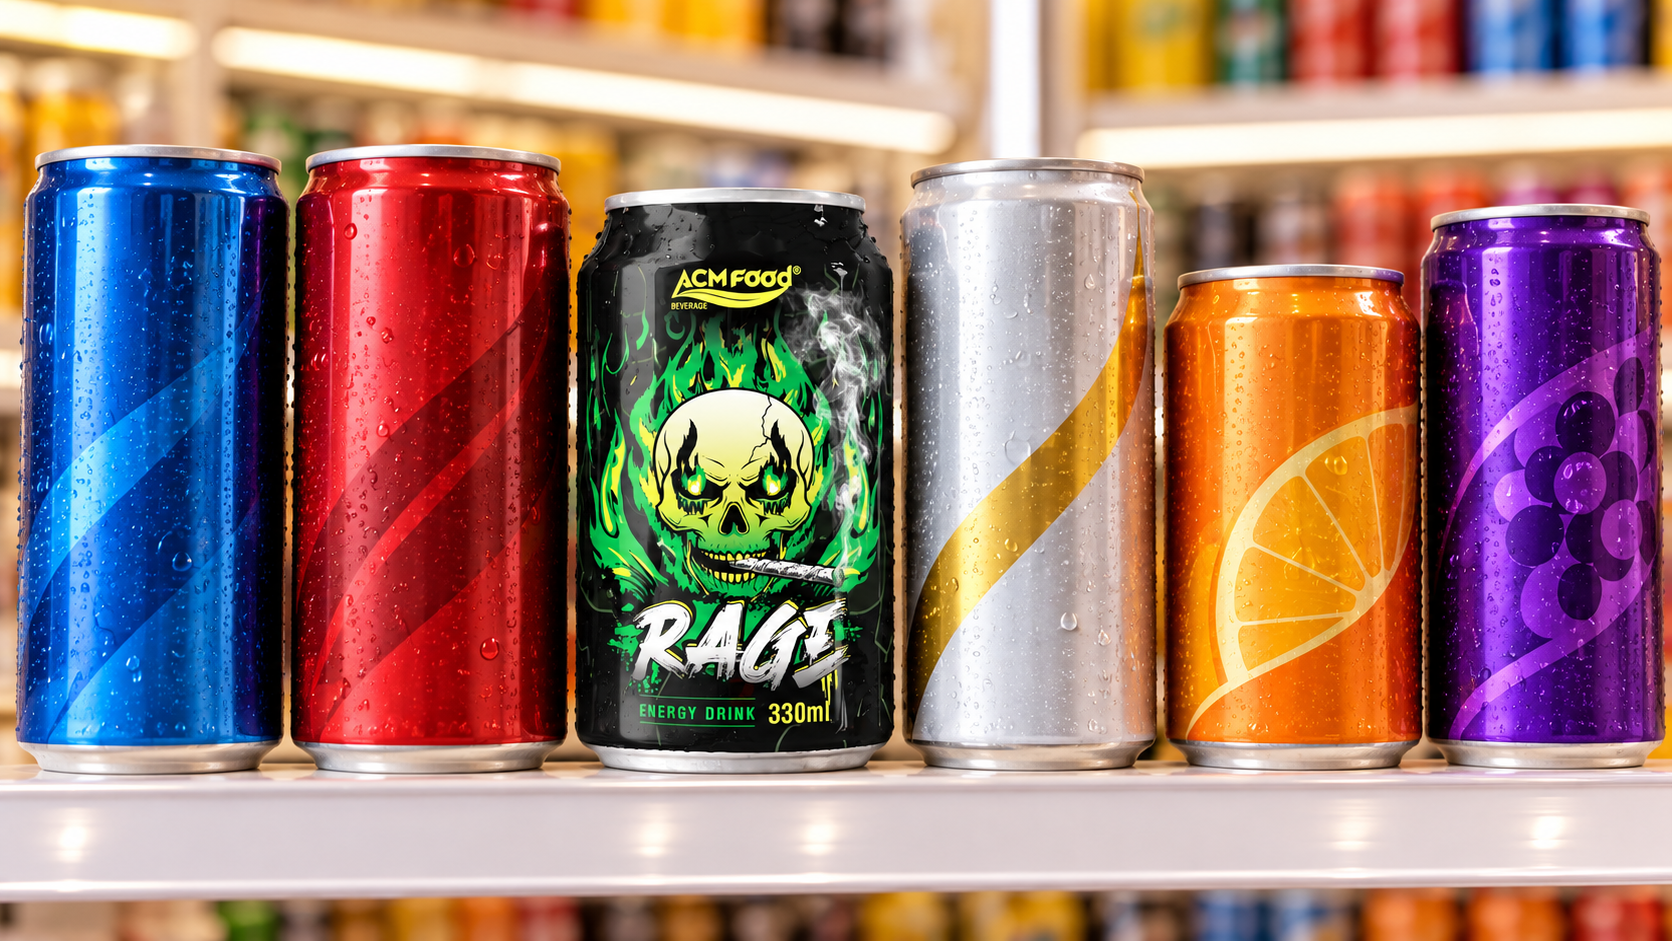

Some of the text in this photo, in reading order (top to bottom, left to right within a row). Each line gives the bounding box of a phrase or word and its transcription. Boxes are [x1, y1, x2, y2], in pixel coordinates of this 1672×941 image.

[670, 302, 708, 310] BEVERAGE
[631, 599, 851, 691] RAGE
[639, 701, 831, 724] ENERGY DRINK 330ml
